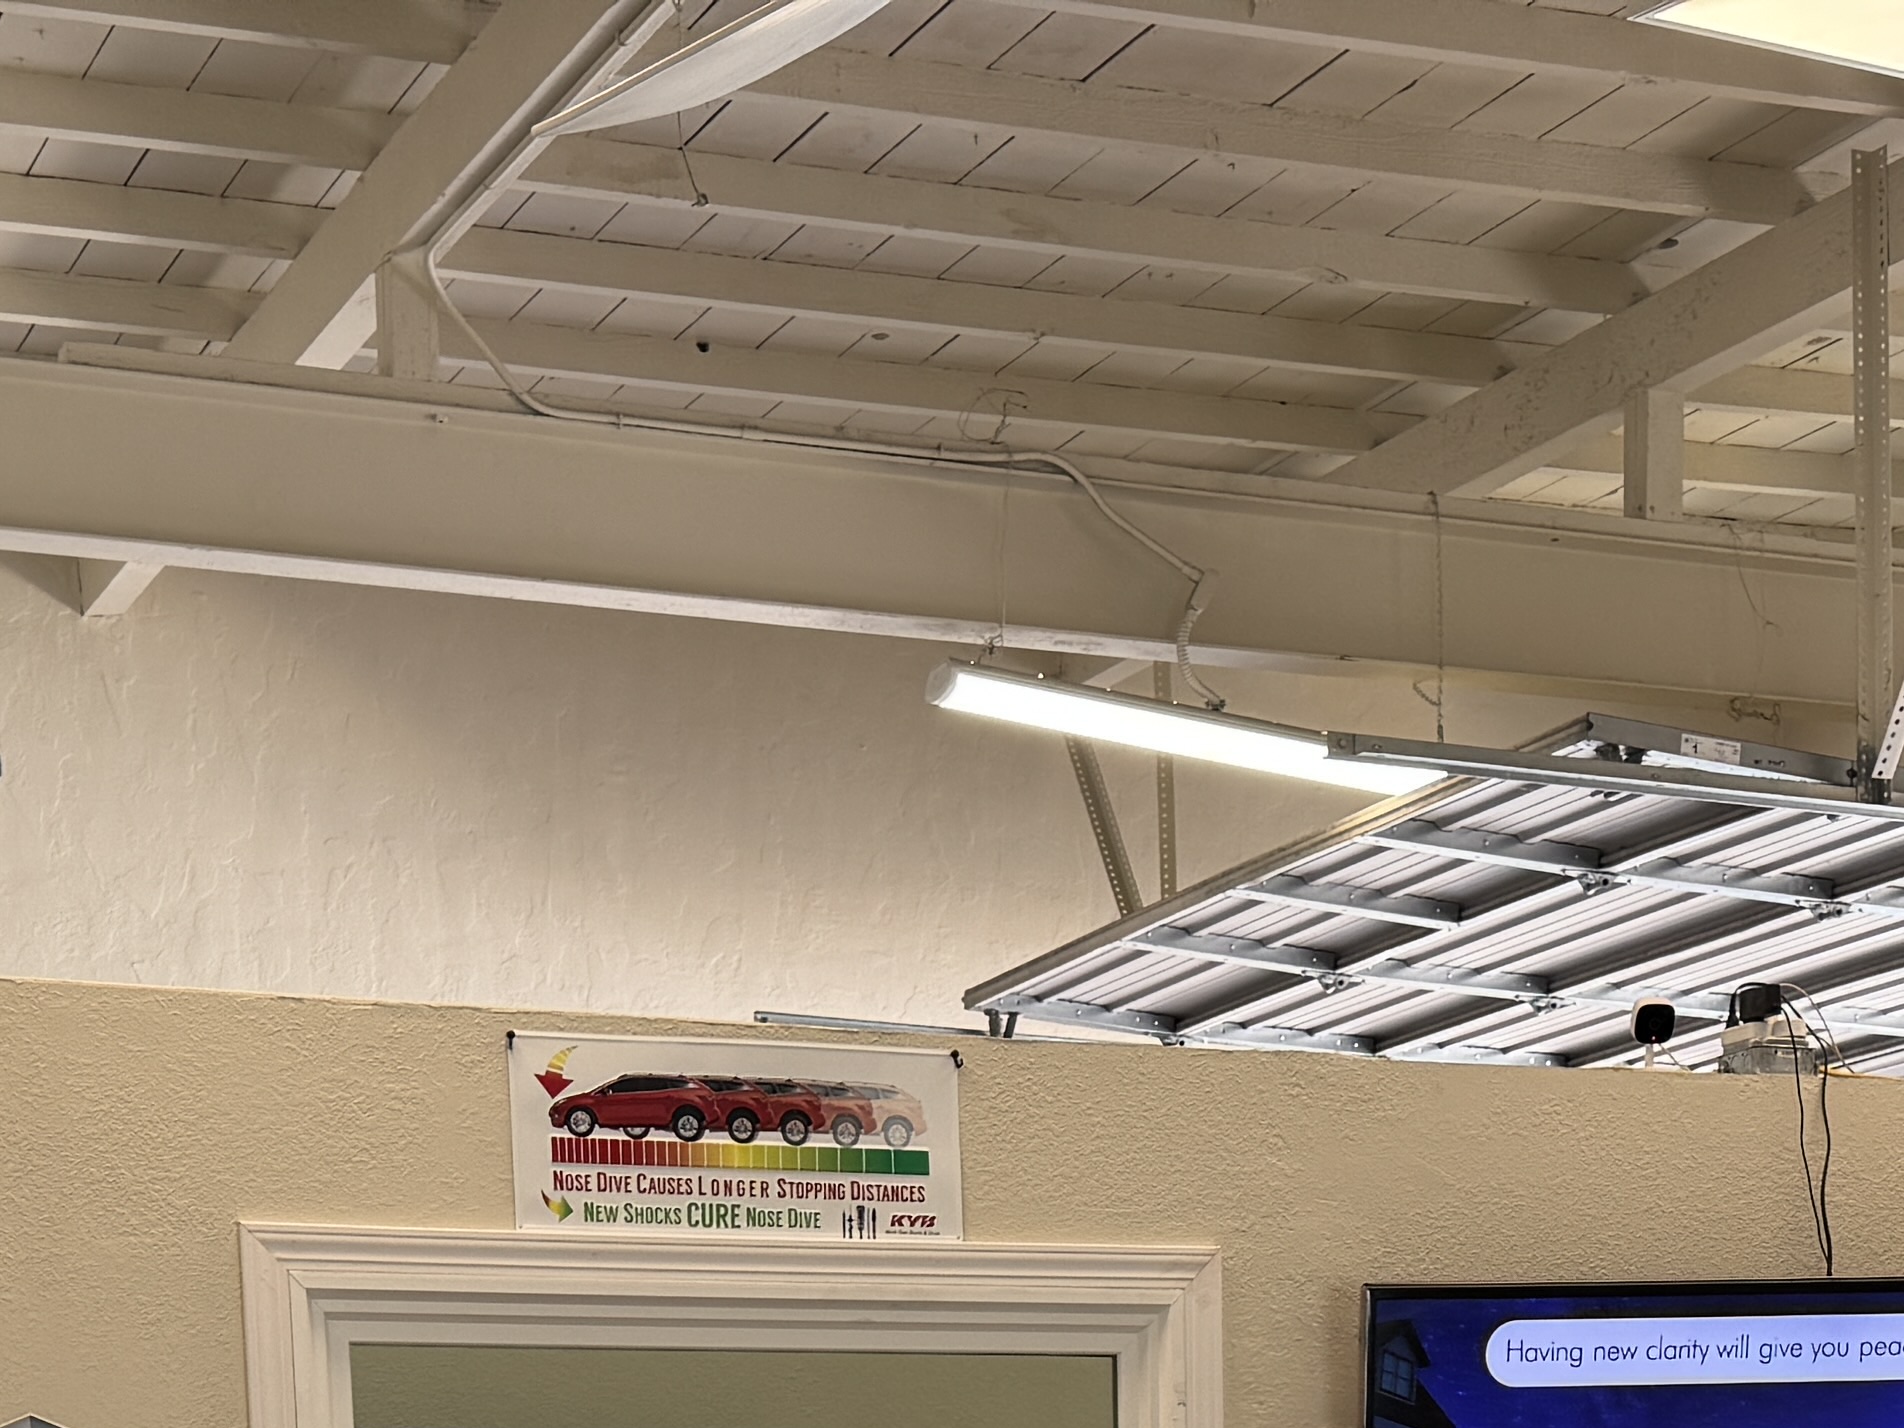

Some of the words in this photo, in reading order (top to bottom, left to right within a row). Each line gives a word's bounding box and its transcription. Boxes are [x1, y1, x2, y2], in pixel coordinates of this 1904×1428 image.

[552, 1170, 592, 1192] NOSE
[597, 1172, 632, 1193] DIVE
[636, 1173, 693, 1196] CAUSES
[698, 1175, 769, 1198] LONGER
[777, 1178, 846, 1201] STOPPING
[850, 1180, 926, 1203] DISTANCES
[583, 1202, 619, 1223] NEW
[623, 1202, 682, 1225] SHOCKS
[687, 1202, 741, 1229] CURE
[746, 1206, 783, 1228] NOSE
[788, 1208, 821, 1229] DIVE
[890, 1214, 937, 1228] KYB
[1506, 1338, 1583, 1368] Having
[1593, 1344, 1638, 1362] new
[1645, 1334, 1710, 1366] clarity
[1717, 1334, 1750, 1360] will
[1759, 1337, 1803, 1364] give
[1810, 1341, 1849, 1364] you
